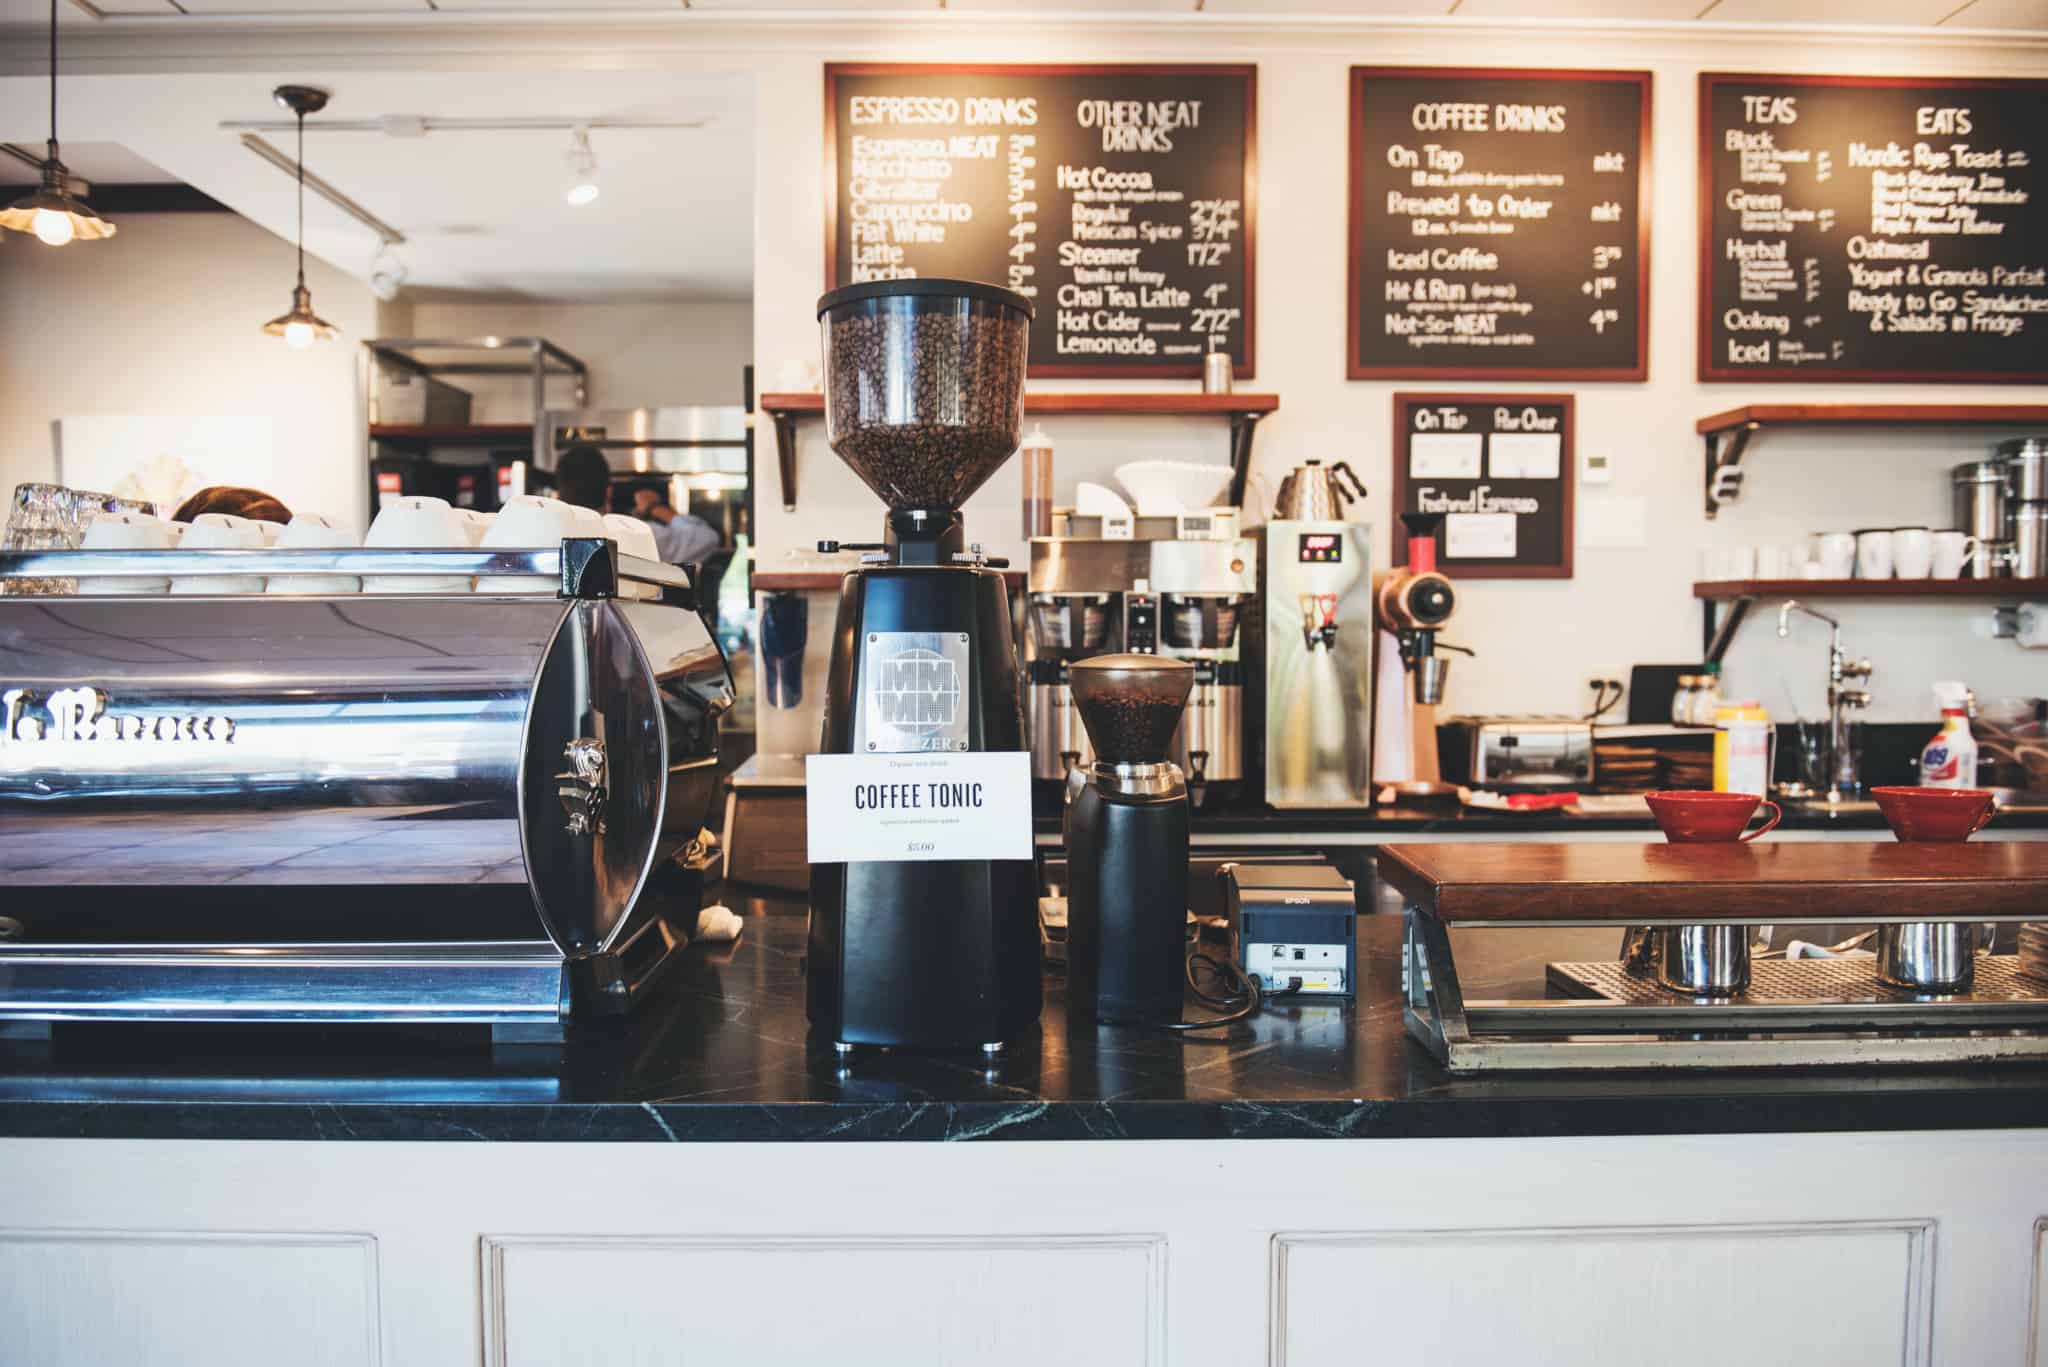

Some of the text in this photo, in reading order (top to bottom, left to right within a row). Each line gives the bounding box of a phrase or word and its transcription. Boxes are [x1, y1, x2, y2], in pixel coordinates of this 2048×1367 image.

[850, 95, 1038, 126] ESPRESSO DRINKS
[1077, 100, 1202, 128] OTHER NEAT
[1412, 103, 1567, 133] COFFEE DRINKS
[1742, 95, 1798, 124] TEAS
[1916, 106, 1974, 135] EATS
[949, 135, 1001, 159] NEAT
[1102, 126, 1174, 152] DRINKS
[1725, 129, 1775, 152] Black
[1387, 144, 1465, 173] On Tap
[1848, 141, 1911, 168] Nordic
[1913, 142, 1950, 171] Rye
[1950, 143, 2004, 168] Toast
[1057, 165, 1153, 190] Hot Cocoa
[1387, 190, 1553, 218] Brewed to Order
[1726, 188, 1783, 211] Green
[850, 201, 973, 223] Cappuccino
[852, 222, 945, 243] Flat White
[1139, 221, 1183, 244] Spice
[852, 244, 905, 265] Latte
[1058, 241, 1141, 267] Steamer
[1387, 247, 1499, 271] Iced Coffee
[1726, 238, 1787, 260] Herbal
[1847, 235, 1930, 260] Oatmeal
[852, 264, 918, 284] Mocha
[1848, 263, 2046, 289] Yogurt & Granola Parfait
[1057, 284, 1103, 308] Chai
[1103, 285, 1138, 308] Tea
[1140, 285, 1192, 308] Latte
[1413, 278, 1427, 300] &
[1429, 278, 1467, 301] Run
[1848, 290, 1902, 315] Ready
[1906, 292, 1926, 312] to
[1928, 291, 1958, 312] Go
[1057, 309, 1141, 332] Hot Cider
[1385, 313, 1499, 335] Not-So-NEAT
[1724, 308, 1790, 335] Oolong
[1870, 311, 2025, 337] & Salads in Fridge
[1057, 333, 1158, 355] Lemonade
[1728, 339, 1771, 363] Iced
[1415, 408, 1469, 430] On Tap
[1520, 408, 1558, 431] Over
[855, 783, 983, 809] COFFEE TONIC
[1284, 896, 1311, 905] EPSON
